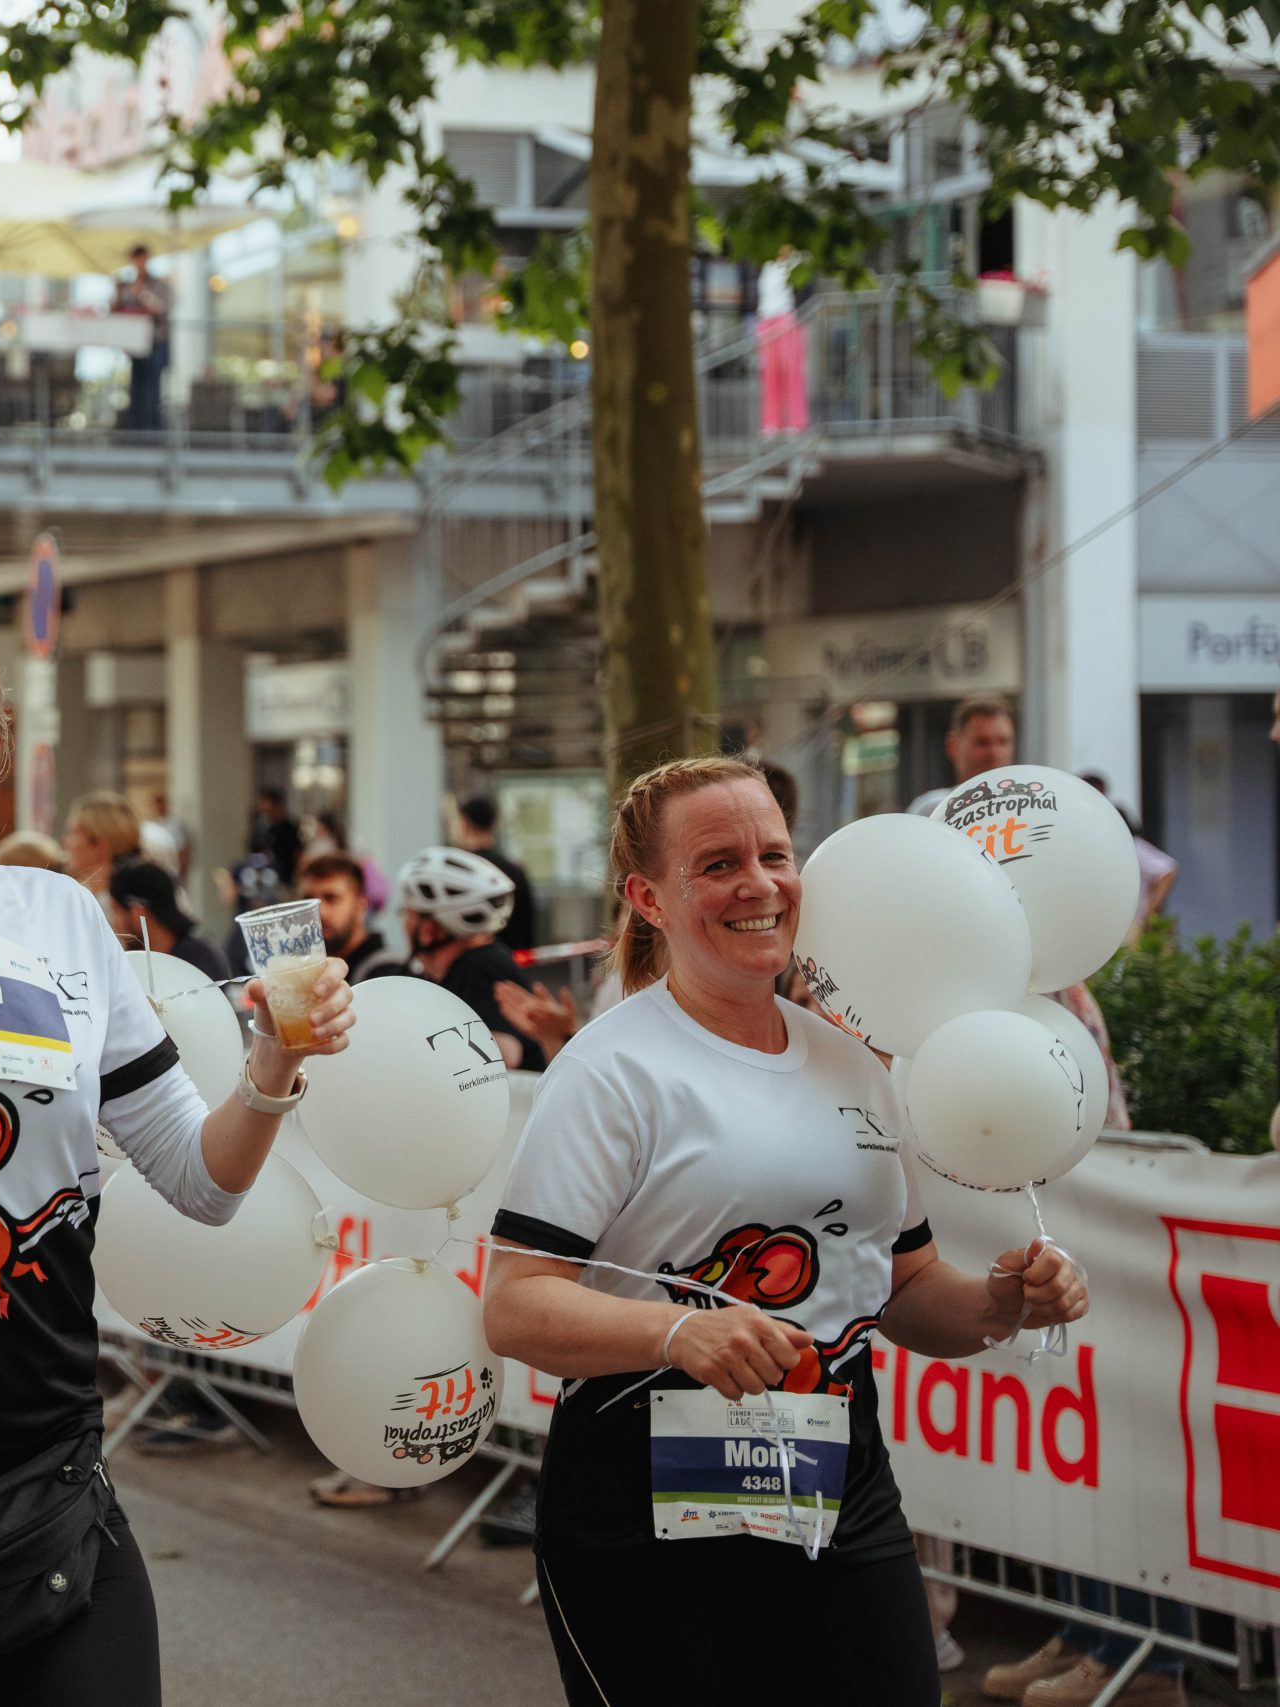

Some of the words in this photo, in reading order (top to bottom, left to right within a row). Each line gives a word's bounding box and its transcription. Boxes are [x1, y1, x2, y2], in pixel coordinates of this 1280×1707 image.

[458, 1074, 490, 1092] tierklinik
[416, 1368, 477, 1421] fit
[383, 1391, 496, 1445] Katzastrophal
[872, 1345, 1099, 1490] land
[724, 1439, 797, 1469] Moni
[741, 1475, 782, 1491] 4348
[683, 1509, 698, 1517] dm
[760, 1512, 781, 1521] BOSCH
